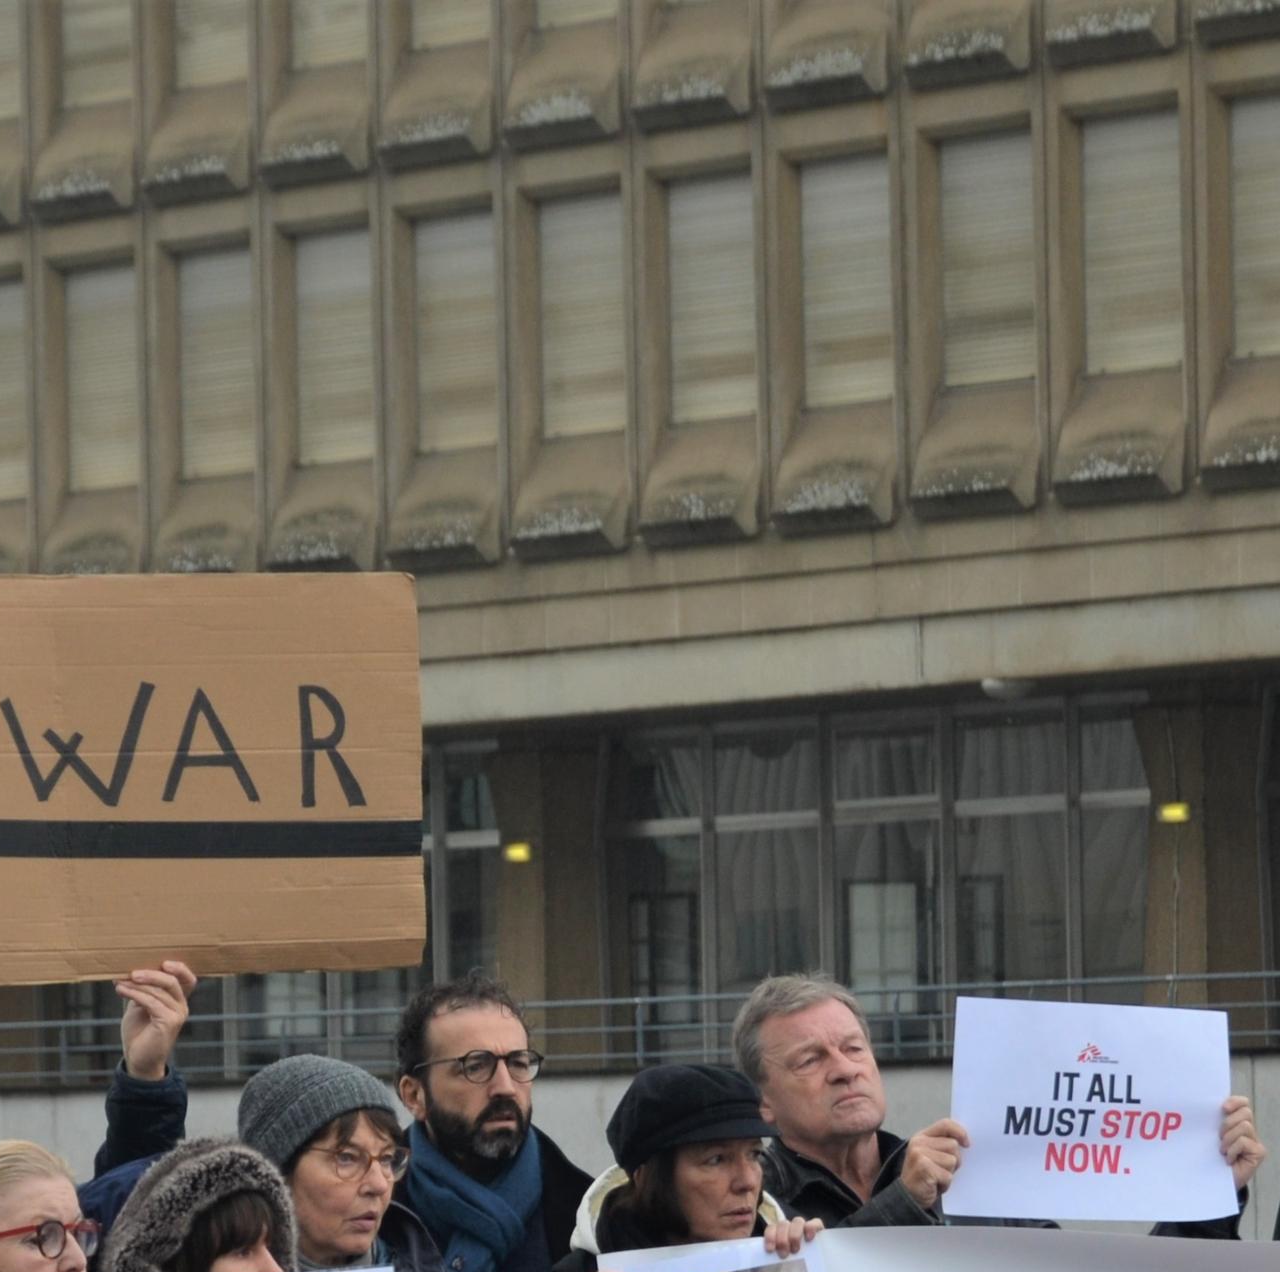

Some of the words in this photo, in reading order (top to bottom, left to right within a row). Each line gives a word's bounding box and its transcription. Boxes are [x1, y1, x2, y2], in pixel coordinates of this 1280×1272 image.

[1052, 1072, 1080, 1101] IT
[1086, 1073, 1141, 1104] ALL
[1003, 1105, 1095, 1137] MUST
[1100, 1110, 1182, 1140] STOP
[1044, 1142, 1130, 1174] NOW.
